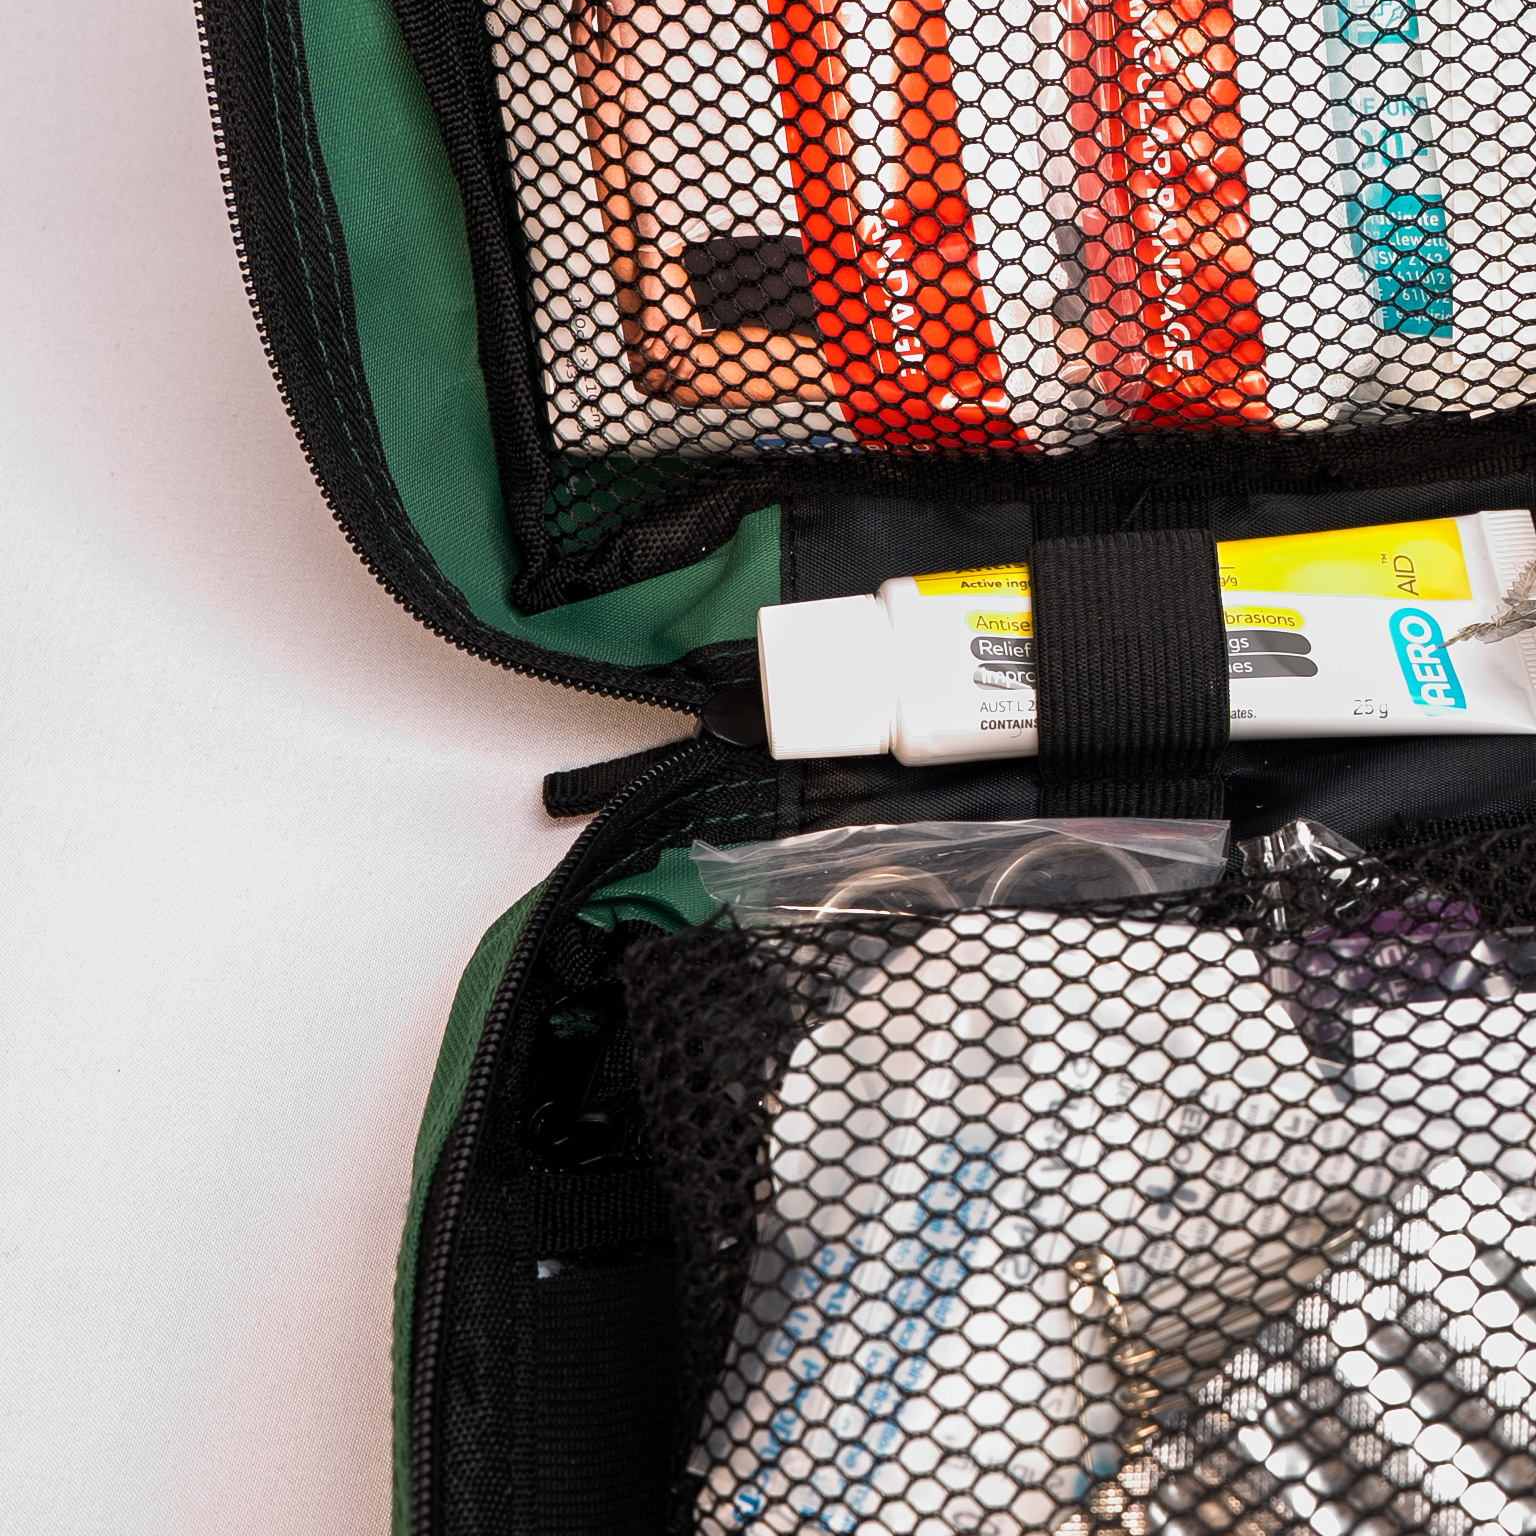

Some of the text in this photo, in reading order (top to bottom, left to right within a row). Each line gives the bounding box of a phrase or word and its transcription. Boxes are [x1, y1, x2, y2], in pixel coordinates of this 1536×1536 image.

[863, 197, 927, 377] ANDAGE
[1147, 186, 1195, 373] BANDAGE
[960, 580, 1002, 589] Active
[1392, 553, 1421, 597] AID
[978, 639, 1032, 659] Relief
[1398, 614, 1458, 706] AERO
[979, 700, 1014, 713] AUST
[1017, 700, 1025, 712] L
[1352, 699, 1390, 719] 25 g
